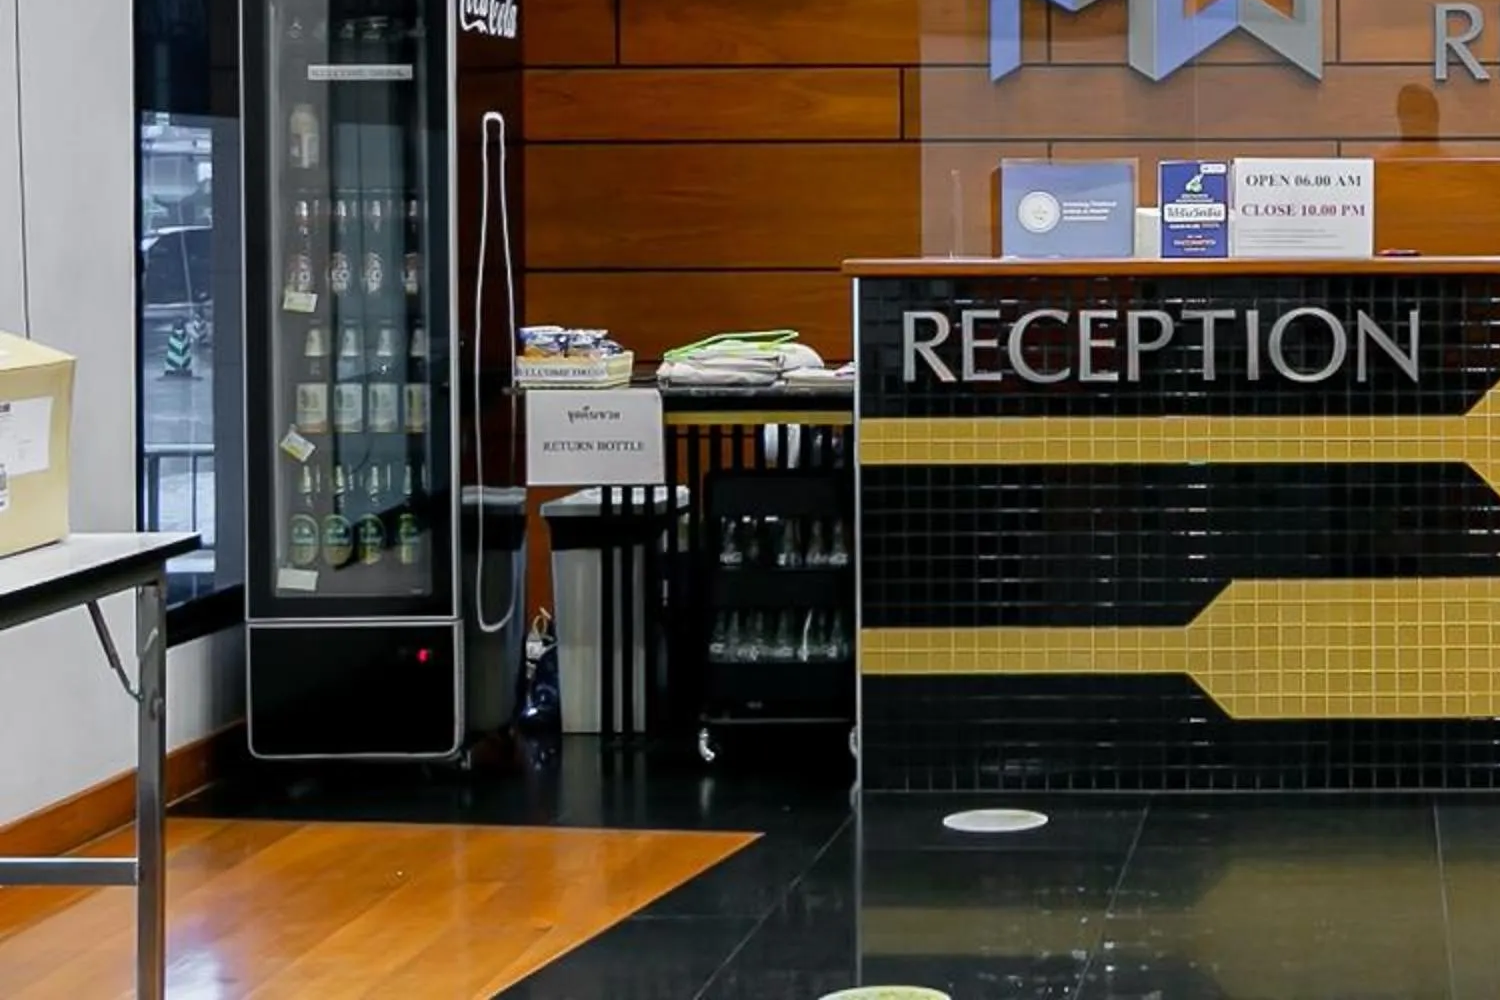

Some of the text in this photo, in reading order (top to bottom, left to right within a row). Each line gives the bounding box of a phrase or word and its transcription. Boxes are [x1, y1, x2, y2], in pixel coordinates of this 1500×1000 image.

[1245, 174, 1361, 187] OPEN 06.00 AM
[1241, 203, 1365, 217] CLOSE 10.00 PM
[903, 307, 1419, 383] RECEPTION
[543, 441, 644, 452] RETURN BOTTLE
